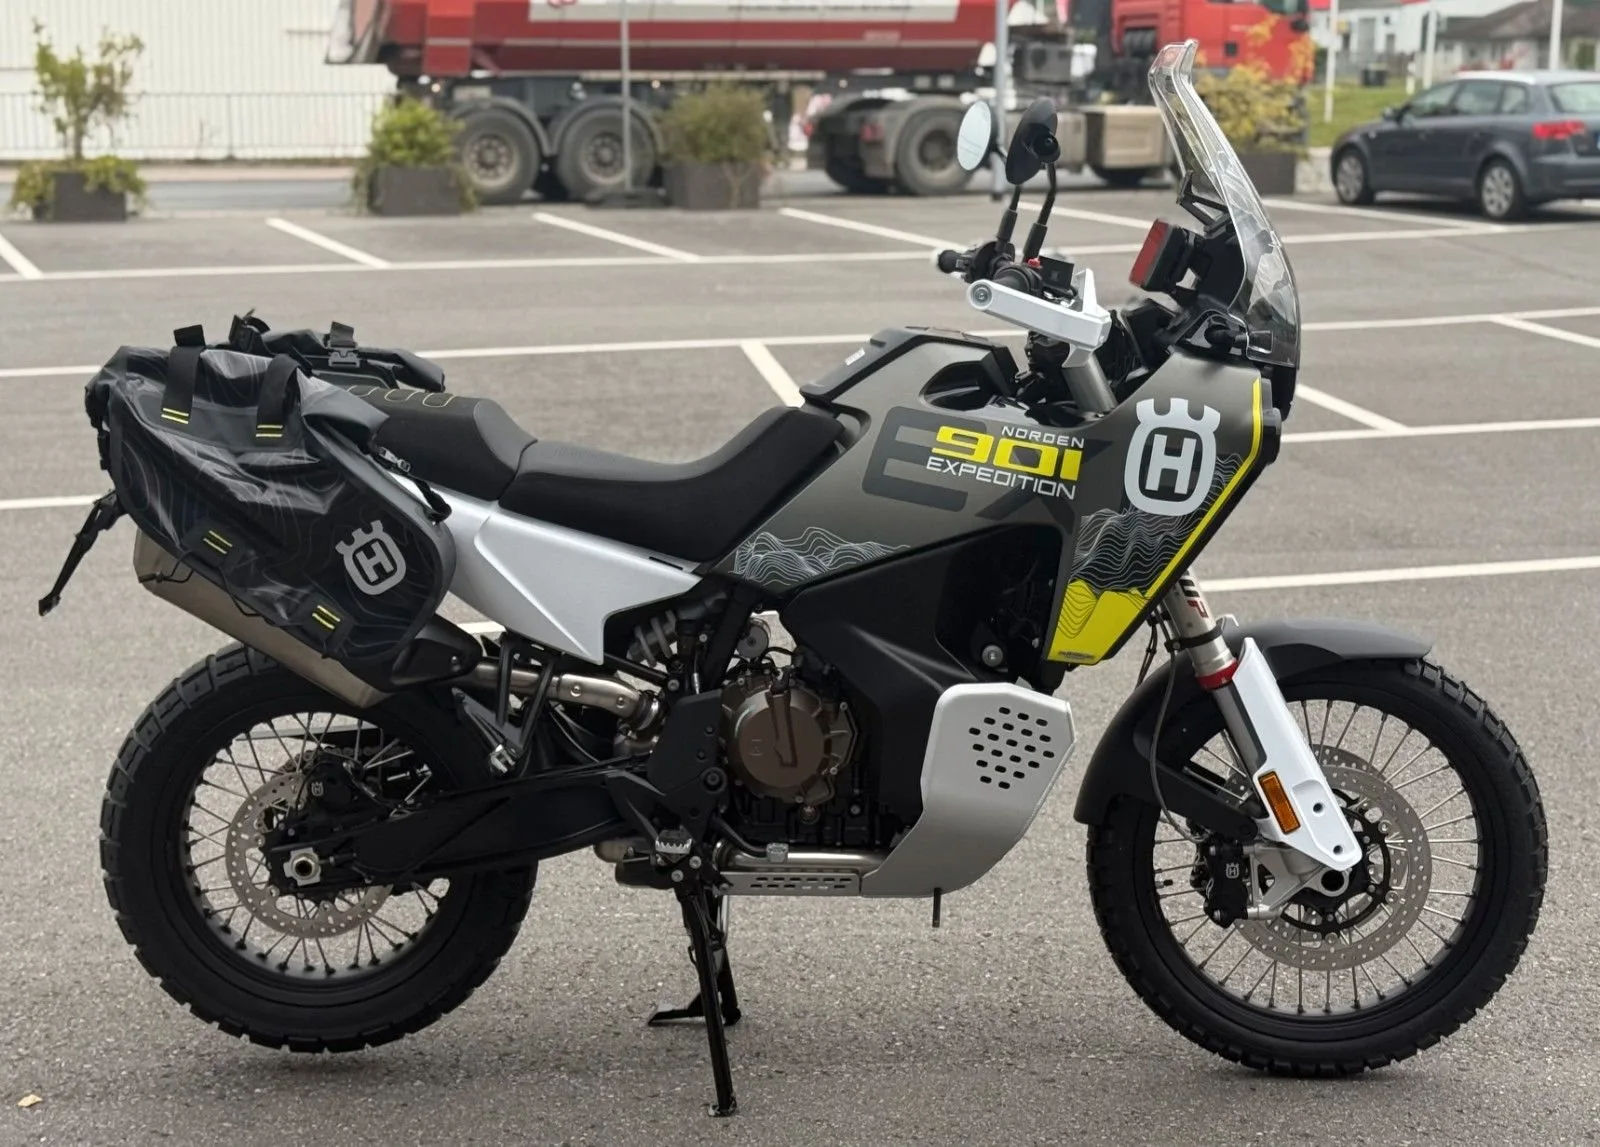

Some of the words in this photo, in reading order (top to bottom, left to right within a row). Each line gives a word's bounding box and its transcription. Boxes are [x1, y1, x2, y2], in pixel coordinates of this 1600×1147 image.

[931, 425, 1083, 481] 901
[1001, 425, 1085, 449] NORDEN
[926, 456, 1076, 500] EXPEDITION
